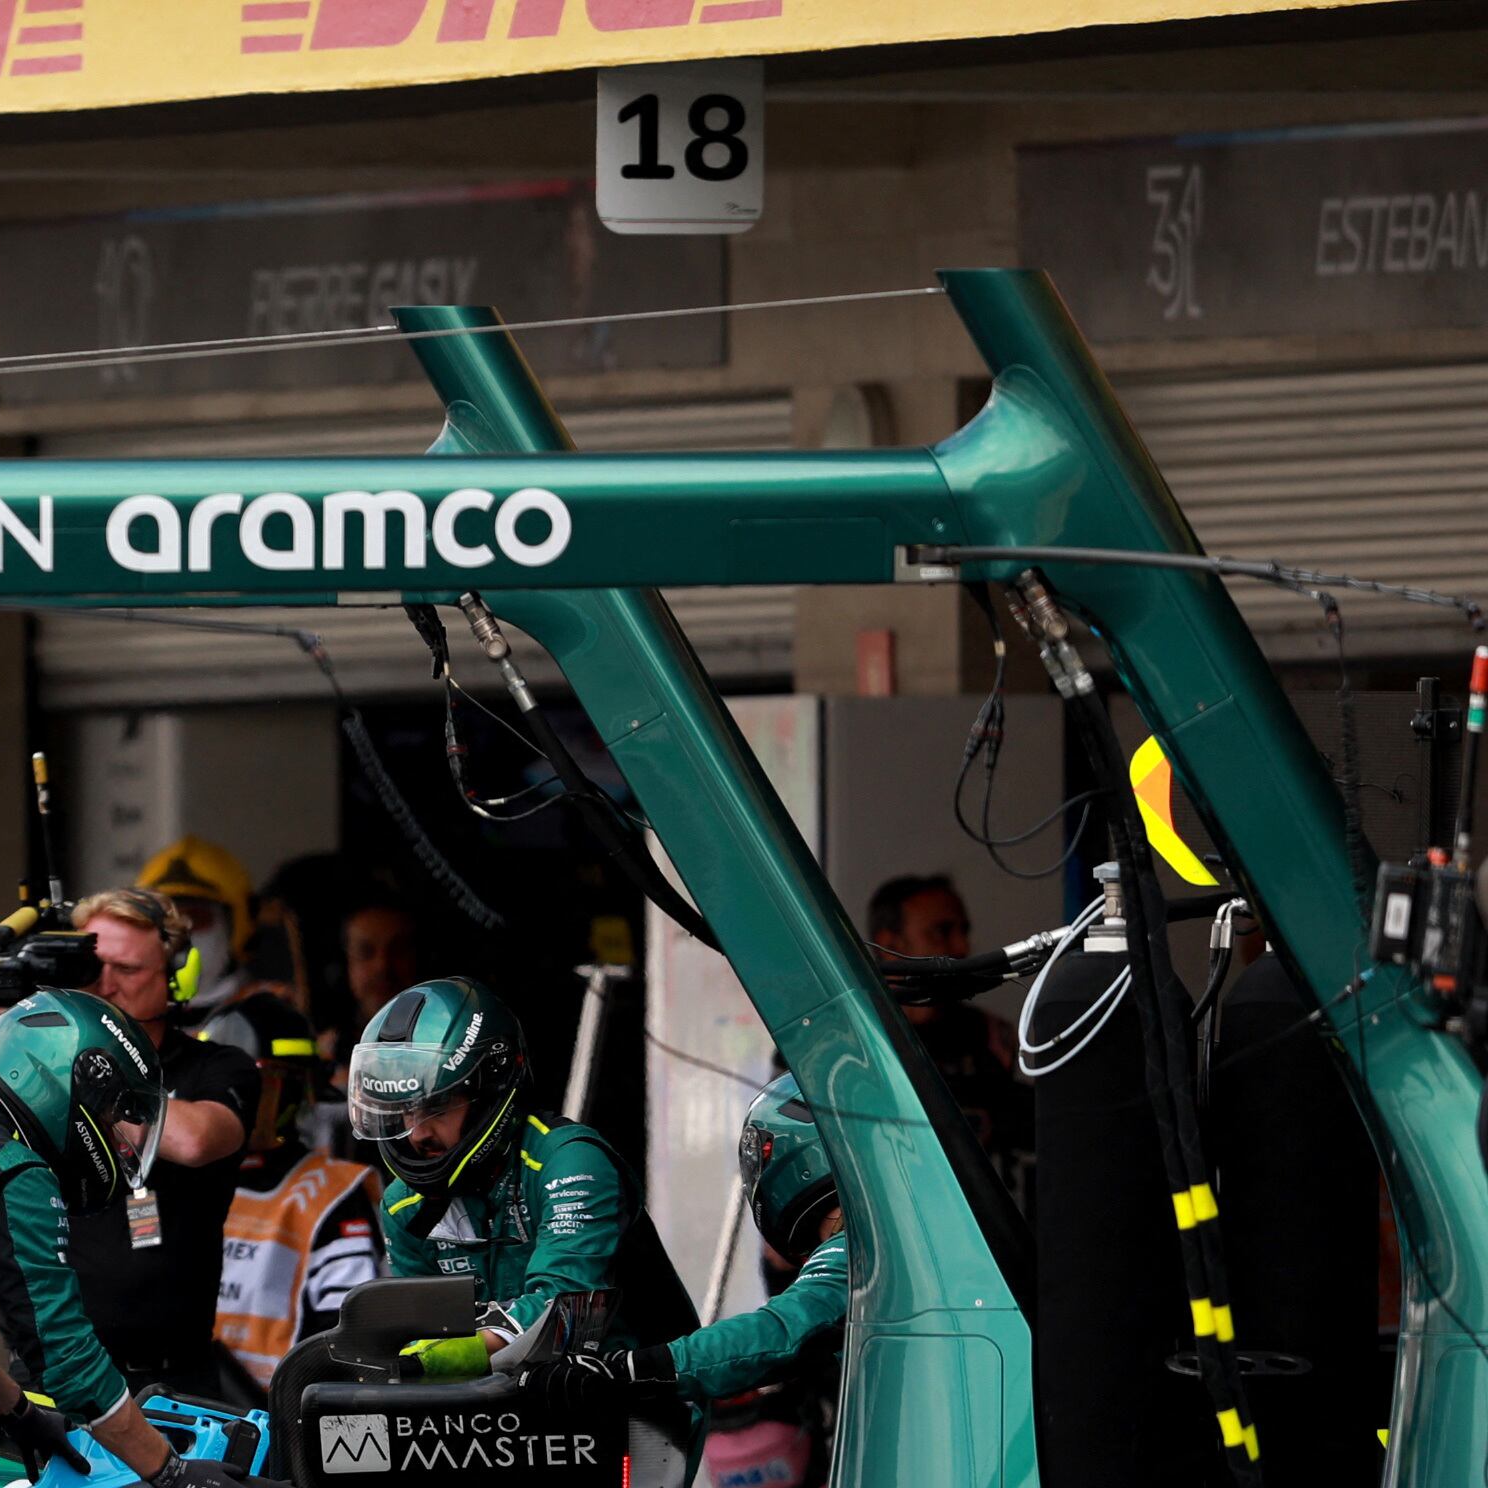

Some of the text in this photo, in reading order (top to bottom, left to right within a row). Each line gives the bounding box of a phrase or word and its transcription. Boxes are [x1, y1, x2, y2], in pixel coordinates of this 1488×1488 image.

[616, 93, 749, 182] 18
[106, 488, 572, 573] aramco
[363, 1077, 420, 1093] aramco
[75, 1121, 110, 1183] ASTON MARTIN
[396, 1413, 520, 1436] BANCO
[401, 1434, 597, 1471] MASTER
